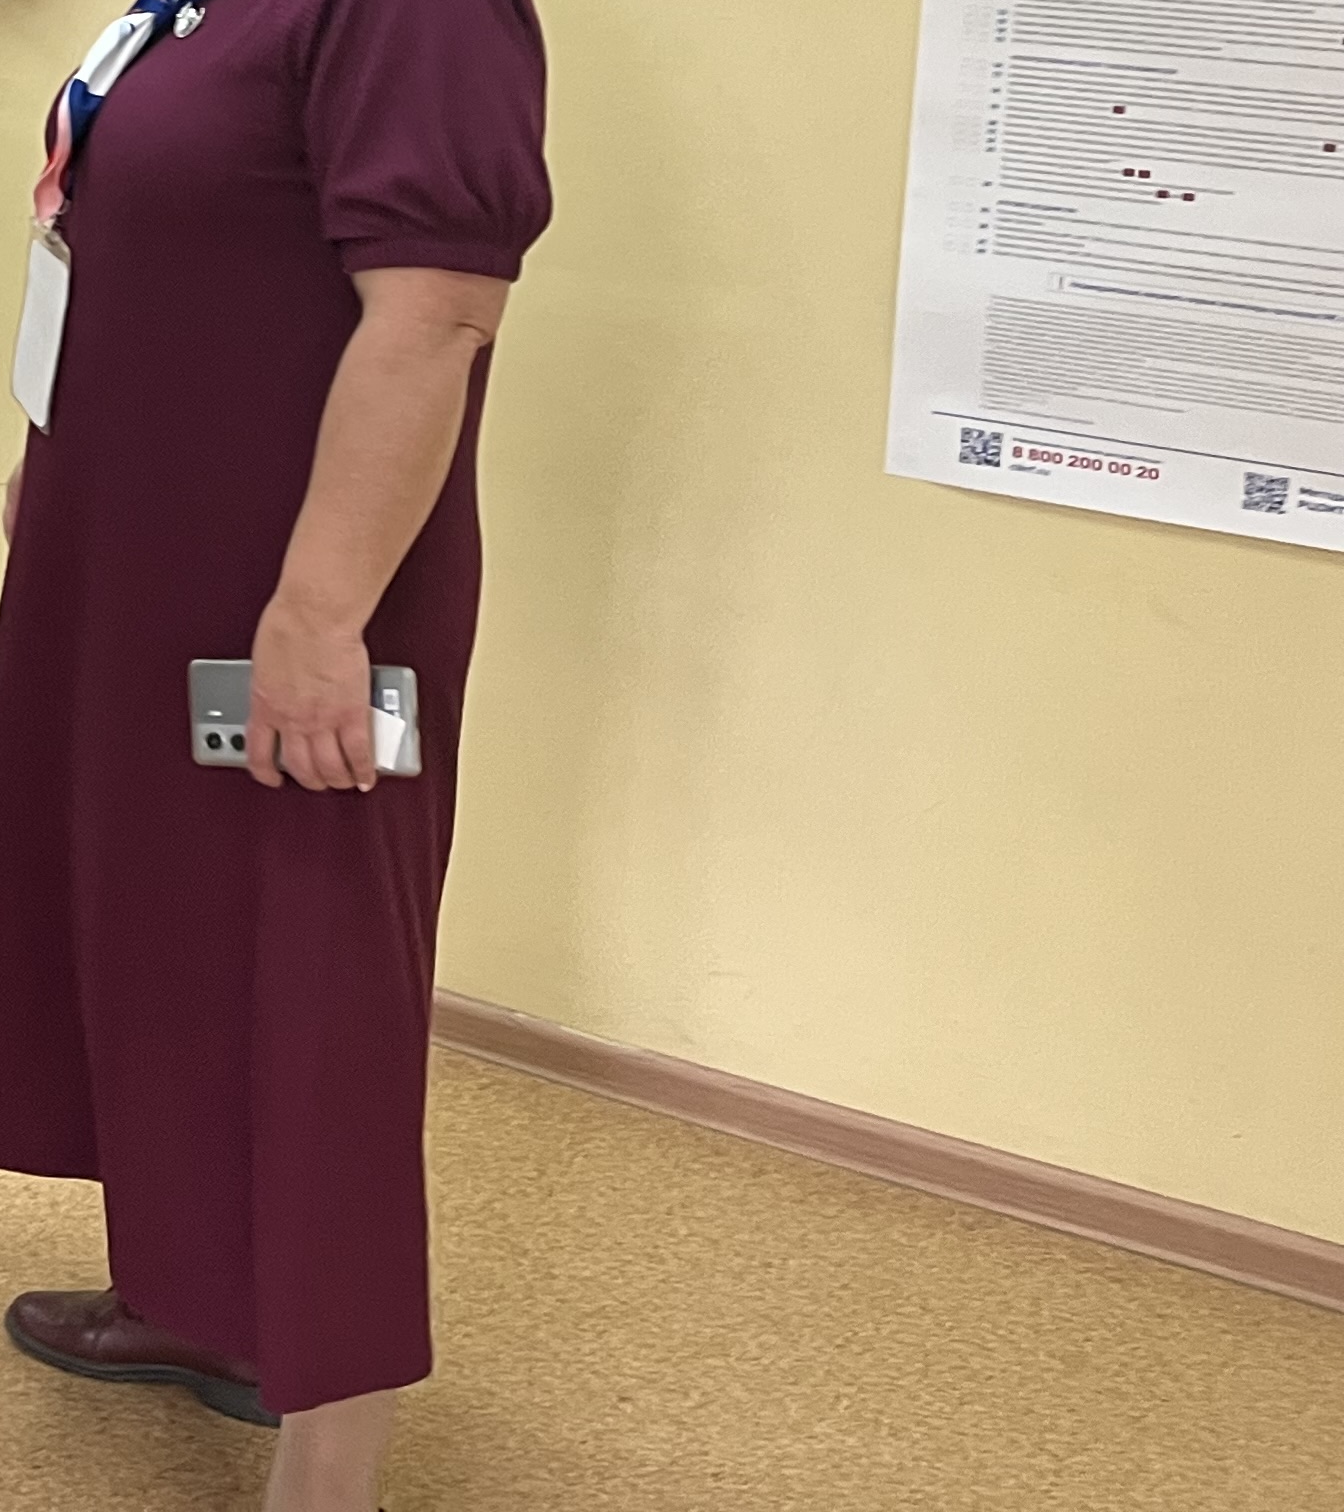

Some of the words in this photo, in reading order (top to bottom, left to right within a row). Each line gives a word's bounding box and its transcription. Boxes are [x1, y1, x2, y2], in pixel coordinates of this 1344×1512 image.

[1012, 446, 1023, 458] 8
[1028, 448, 1063, 464] 800
[1067, 455, 1103, 471] 200
[1108, 461, 1131, 476] 00
[1135, 466, 1160, 480] 20
